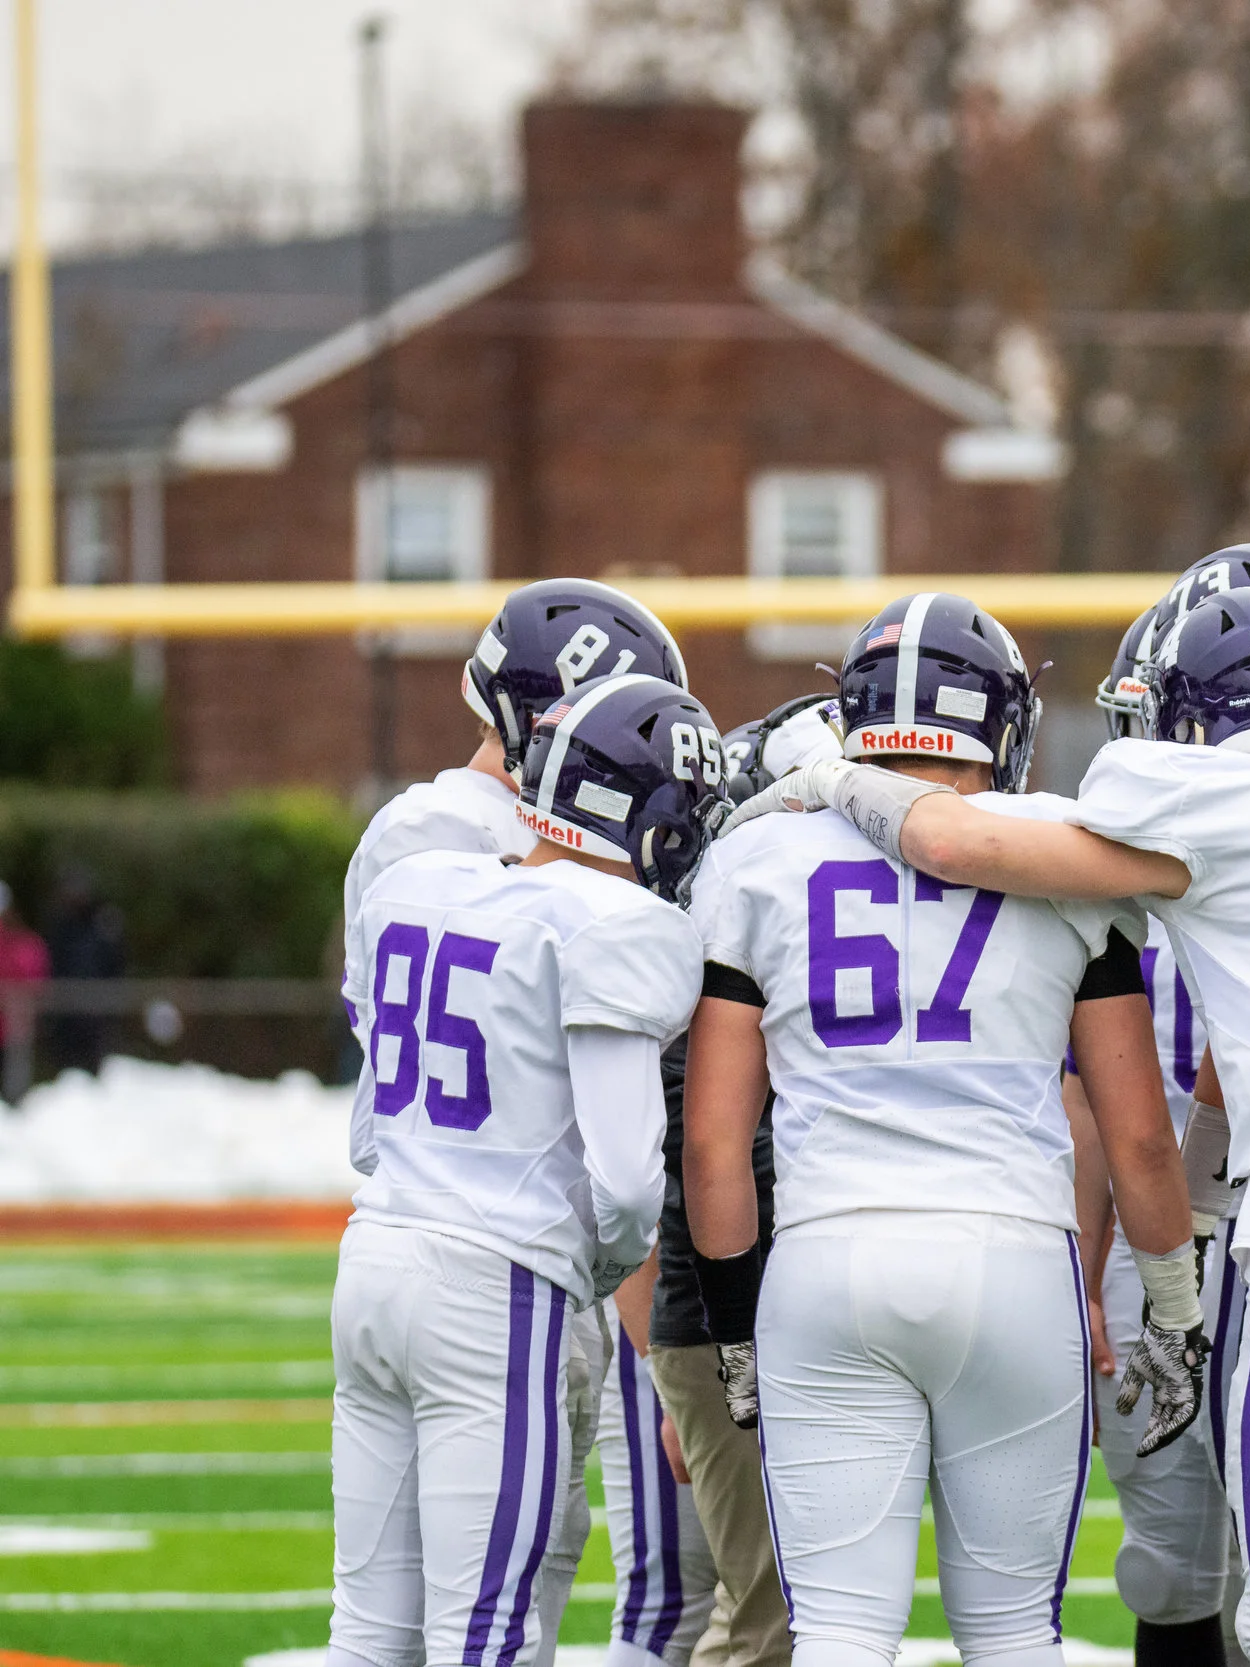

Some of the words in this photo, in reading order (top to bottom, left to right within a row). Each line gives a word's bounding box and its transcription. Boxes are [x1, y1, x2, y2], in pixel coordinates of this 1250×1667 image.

[1169, 562, 1230, 624] 73
[1158, 616, 1190, 669] 4
[1120, 681, 1149, 694] Ridde
[670, 721, 721, 786] 85
[861, 730, 953, 752] Riddell
[515, 804, 583, 848] Riddell
[867, 809, 888, 839] FOR
[808, 858, 1005, 1048] 67
[371, 921, 500, 1131] 85
